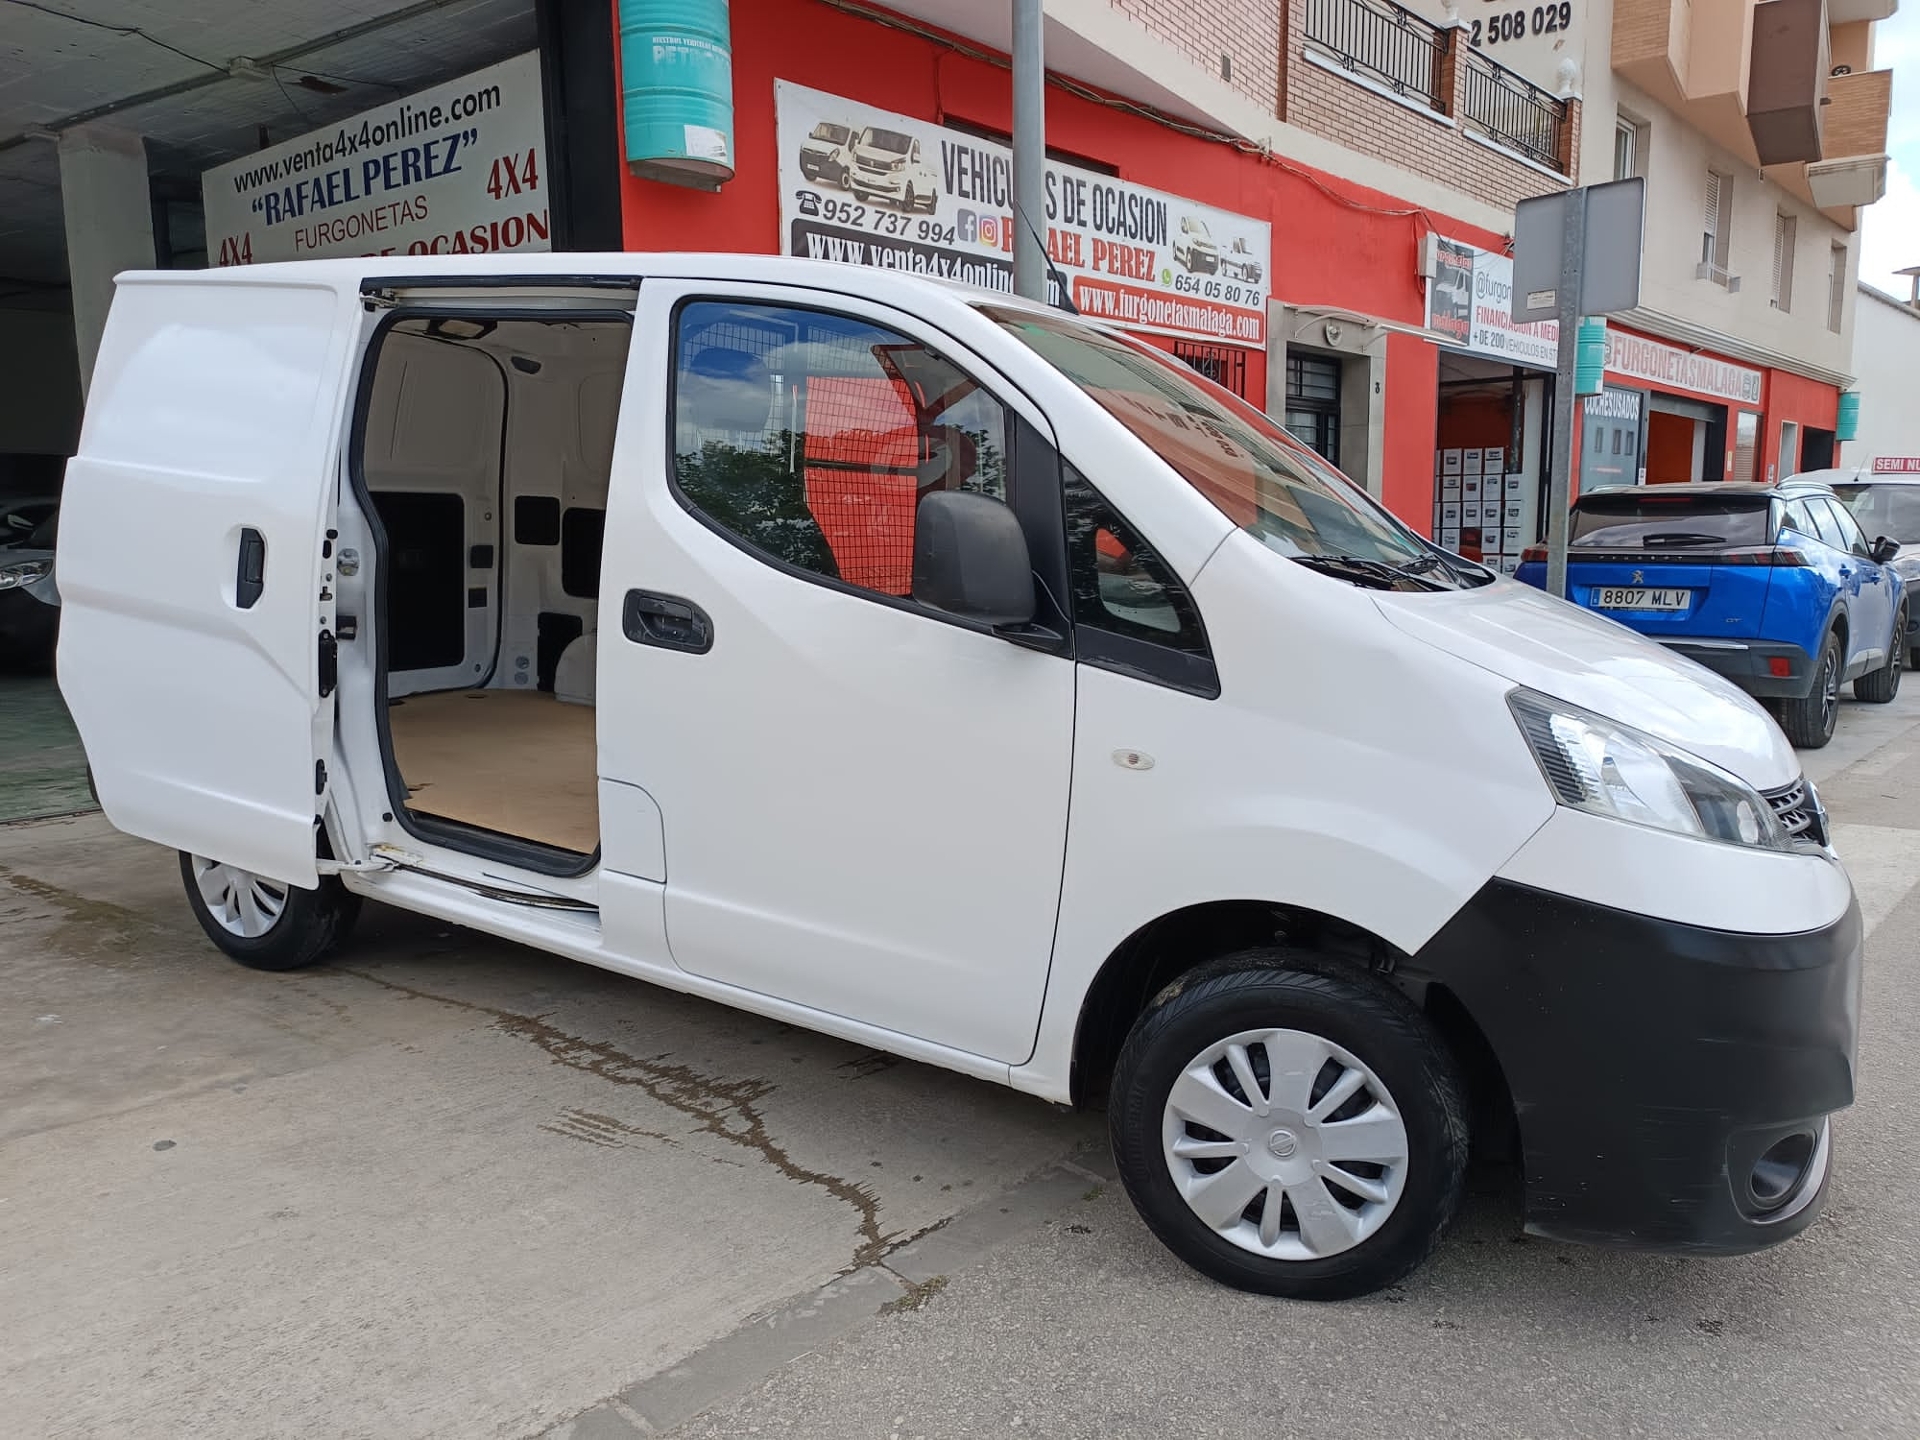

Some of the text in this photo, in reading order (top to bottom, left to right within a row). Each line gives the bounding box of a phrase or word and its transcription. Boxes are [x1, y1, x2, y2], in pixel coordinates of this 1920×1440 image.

[1488, 10, 1525, 44] 508
[1532, 1, 1571, 35] 029
[234, 85, 501, 193] www.venta4x4online.com
[486, 148, 539, 200] 4X4
[942, 140, 1167, 246] VEHICUS DE OCASION
[295, 195, 429, 252] FURGONETAS
[823, 199, 955, 245] 952 737 994
[219, 232, 252, 267] 4X4
[1001, 216, 1155, 282] RAEL PEREZ
[1079, 285, 1260, 340] www.furgonetasmalaga.com
[1175, 275, 1260, 307] 654 05 80 76
[1479, 329, 1489, 346] DE
[1491, 332, 1504, 349] 200
[1876, 458, 1905, 470] SEMI
[1603, 590, 1685, 606] 8807 MLV
